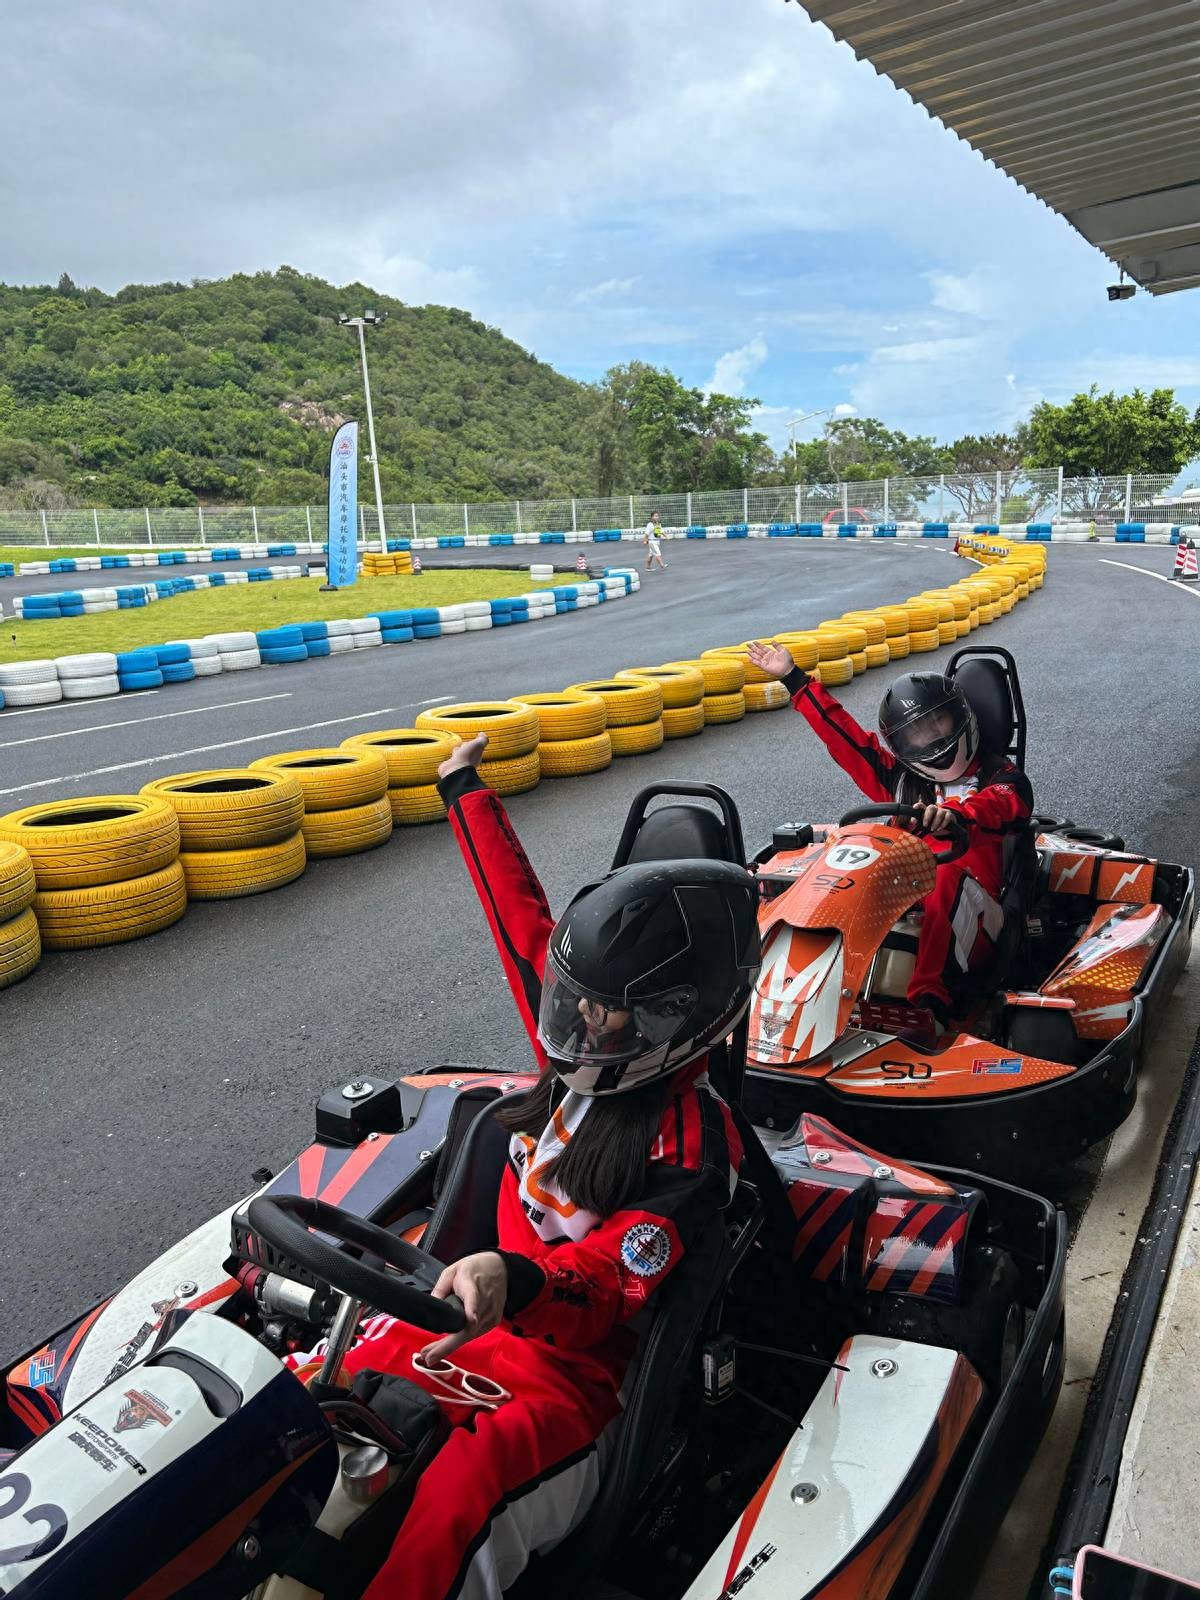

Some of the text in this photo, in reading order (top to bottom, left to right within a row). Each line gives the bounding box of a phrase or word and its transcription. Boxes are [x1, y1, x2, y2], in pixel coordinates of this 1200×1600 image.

[836, 848, 870, 865] 19
[72, 1413, 147, 1475] KEEPOWER
[84, 1430, 119, 1461] MOTORSPORTS
